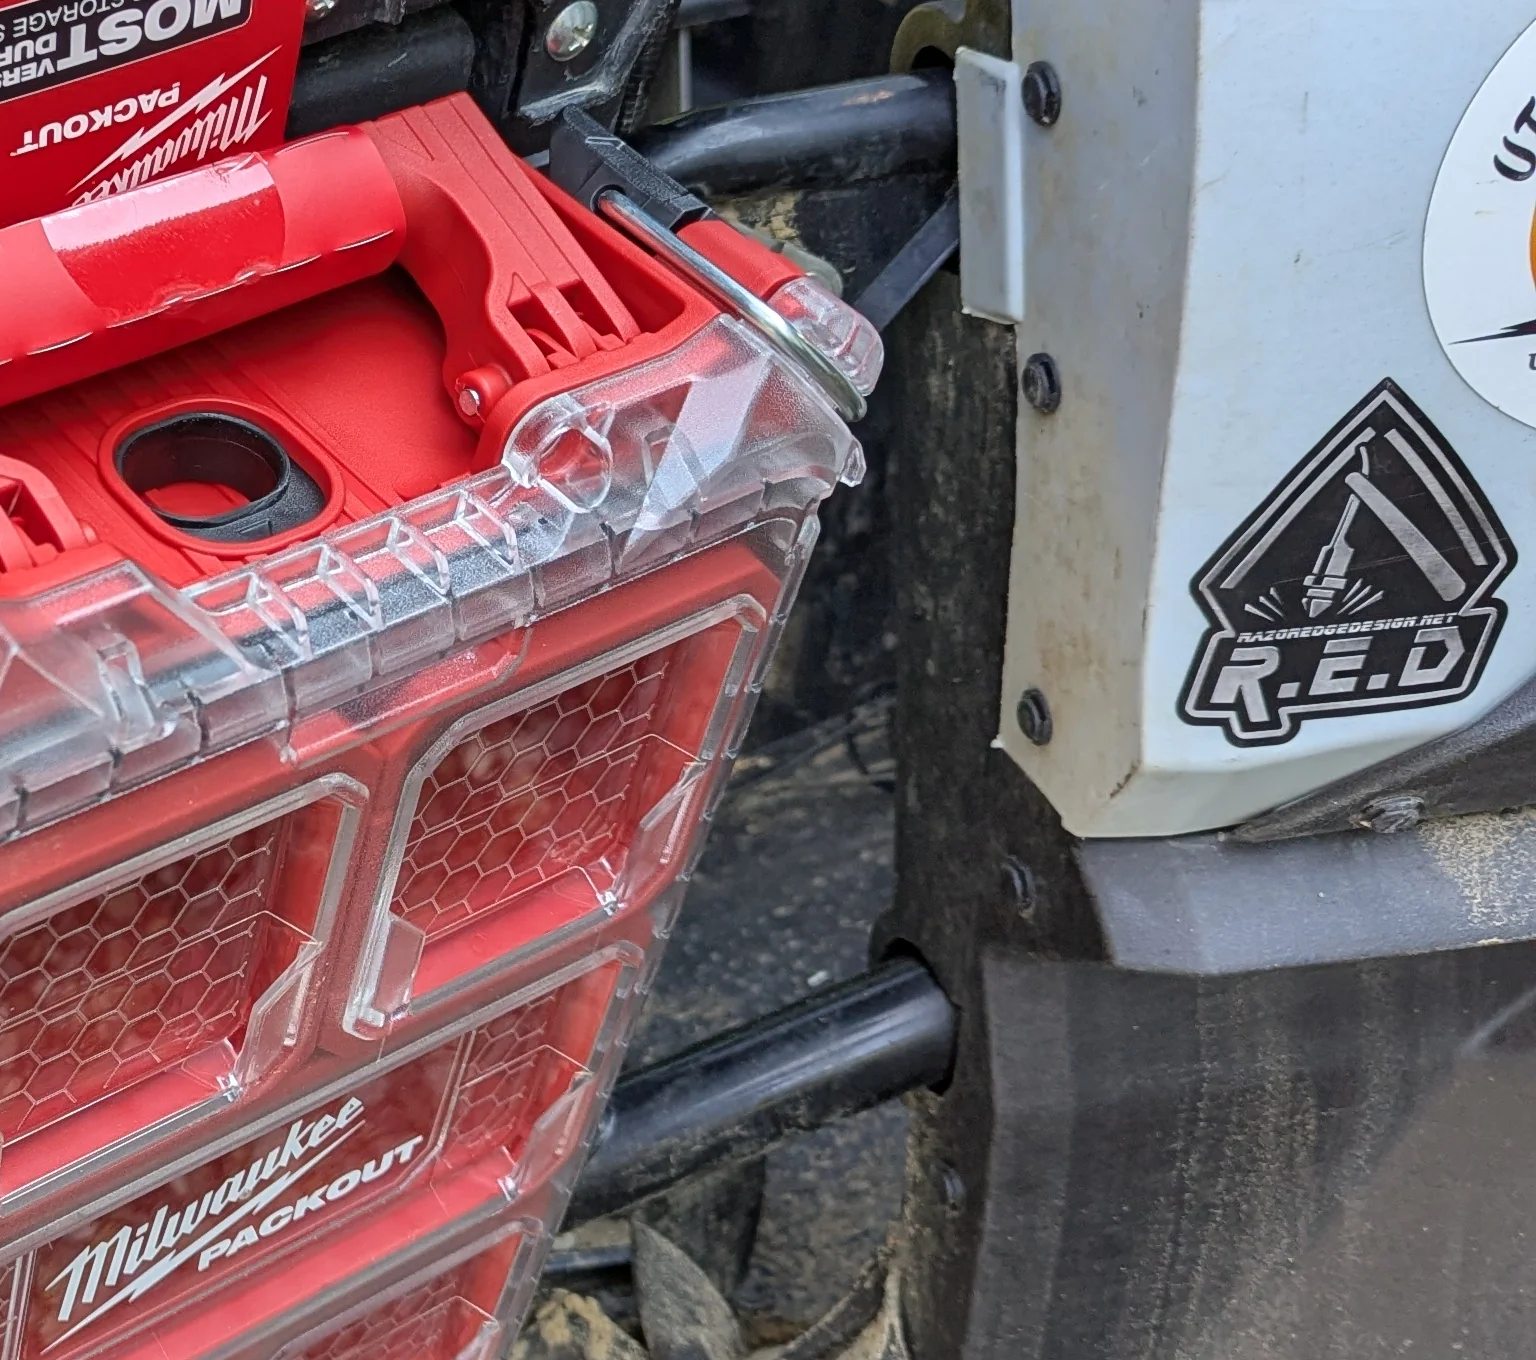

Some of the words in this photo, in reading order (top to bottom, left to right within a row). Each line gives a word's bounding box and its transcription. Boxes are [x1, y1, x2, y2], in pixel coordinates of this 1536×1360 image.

[12, 82, 180, 156] PACKOUT
[1210, 625, 1466, 723] R.E.D
[1236, 612, 1458, 644] RAZOREDGEDESIGN.NET
[44, 1096, 366, 1323] Milwaukee
[197, 1135, 424, 1273] PACKOUT
